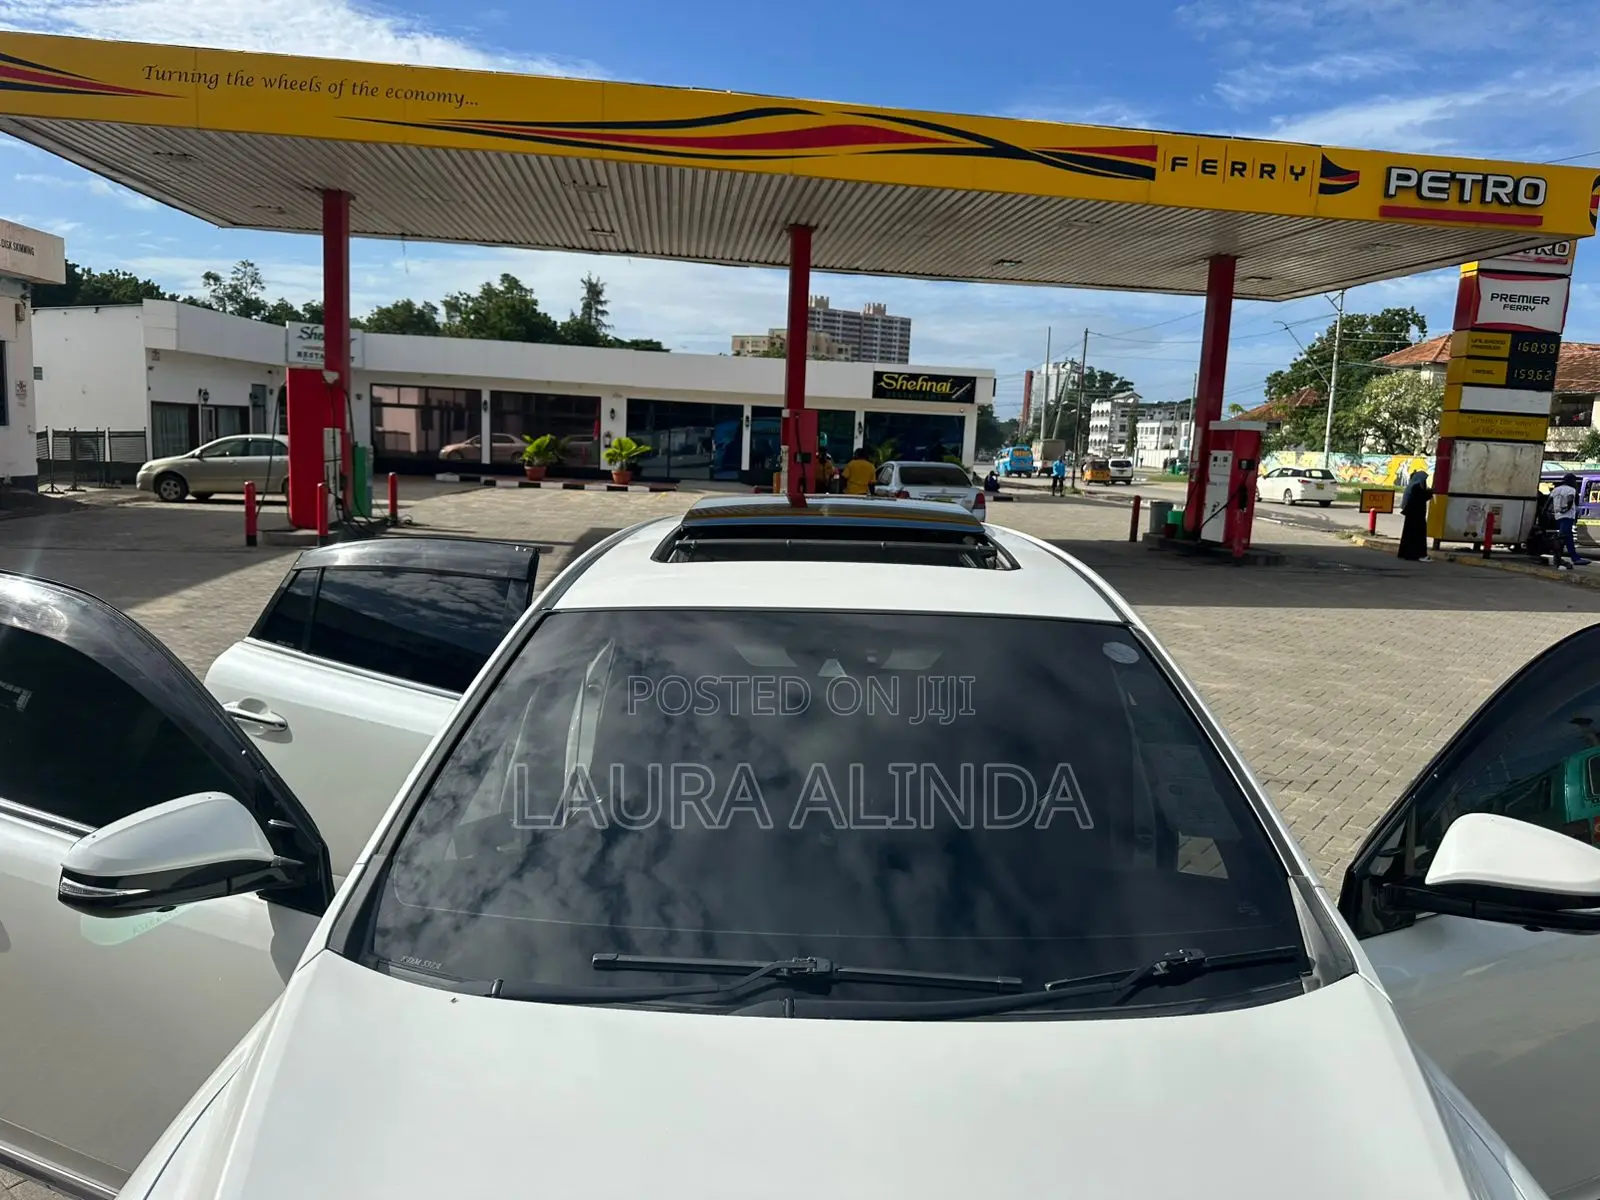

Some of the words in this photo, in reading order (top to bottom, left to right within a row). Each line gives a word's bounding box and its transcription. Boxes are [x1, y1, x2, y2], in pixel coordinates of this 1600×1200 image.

[142, 64, 219, 90] Turning
[226, 70, 254, 87] the
[262, 73, 322, 93] wheels
[328, 78, 348, 99] of
[351, 80, 379, 97] the
[385, 87, 478, 109] economy...
[1170, 156, 1306, 182] FERRY
[1384, 166, 1548, 207] PETRO
[1490, 293, 1550, 305] PREMIER
[1502, 303, 1536, 312] FERRY
[878, 373, 955, 393] Shehnai
